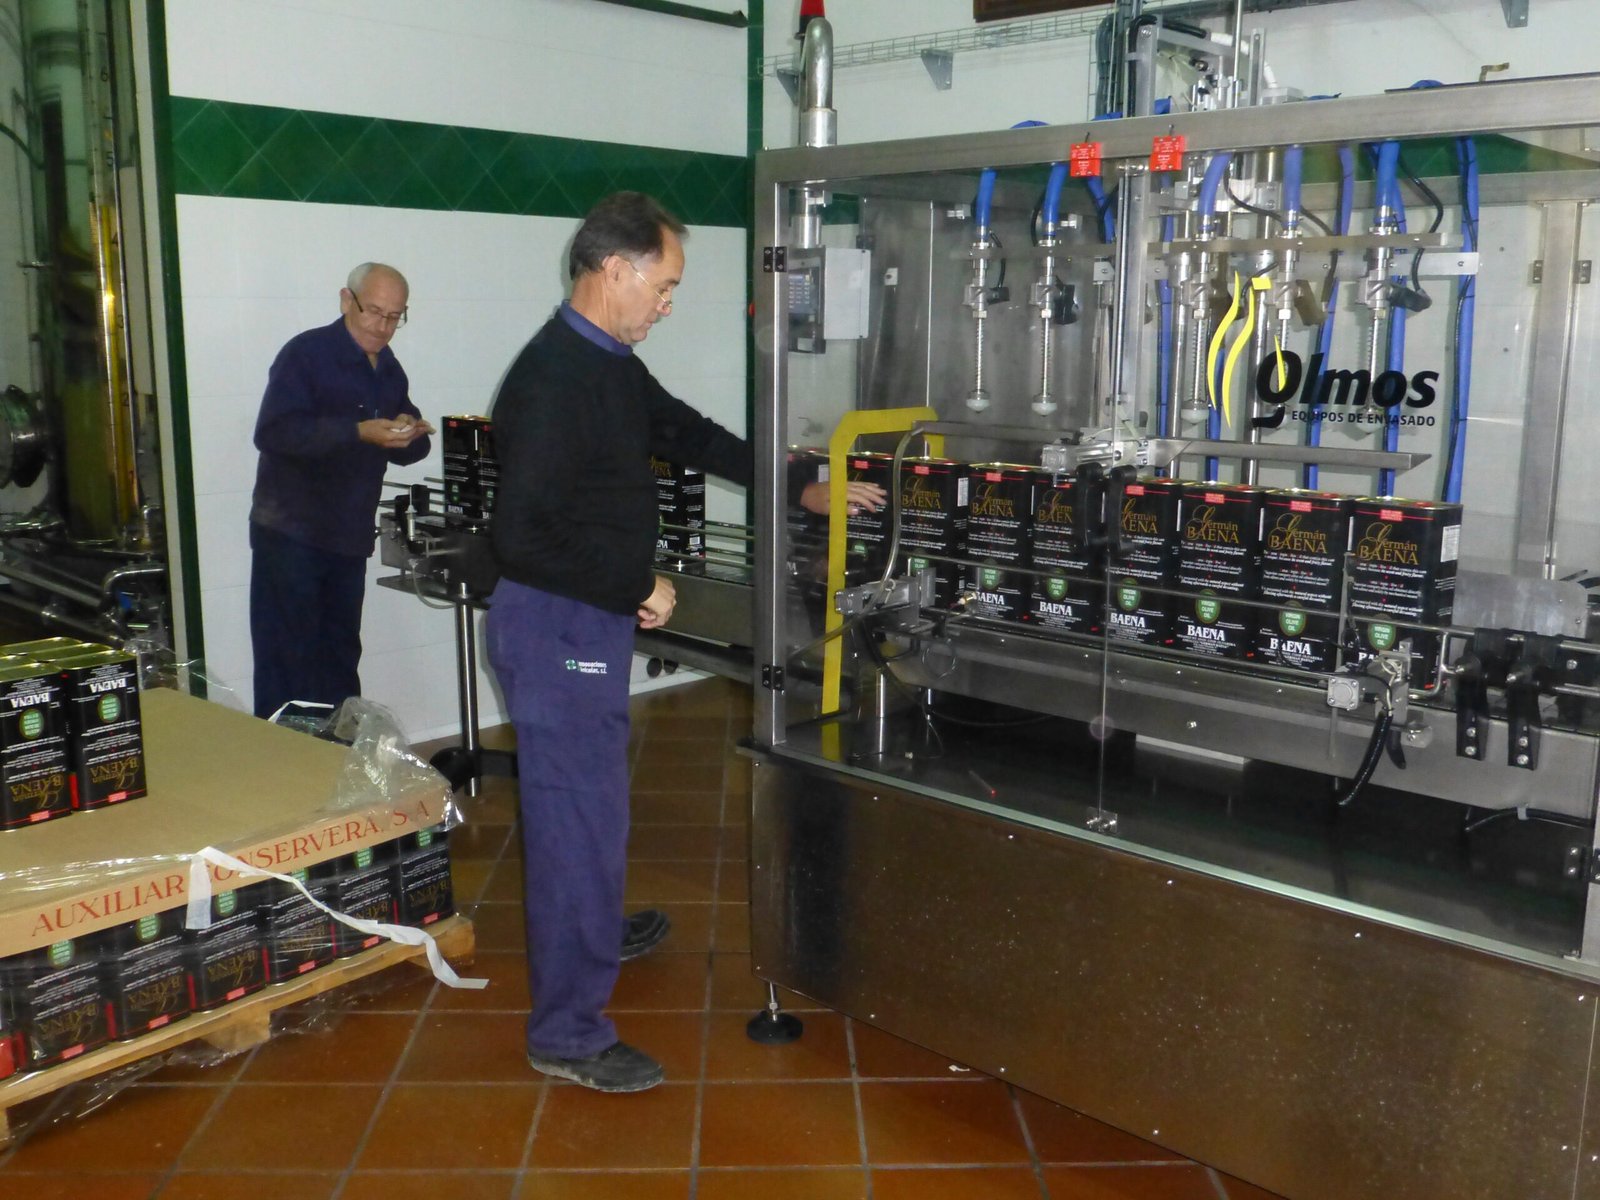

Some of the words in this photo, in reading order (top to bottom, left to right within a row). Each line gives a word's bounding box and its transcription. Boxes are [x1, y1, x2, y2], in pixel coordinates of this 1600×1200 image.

[1250, 349, 1439, 428] Olmos
[1291, 410, 1344, 423] EQUIPOS
[1348, 412, 1363, 423] DE
[1367, 413, 1435, 427] ENVASADO
[972, 502, 1015, 518] BAENA
[1038, 509, 1073, 523] BAEN
[1186, 525, 1240, 544] BAENA
[1269, 534, 1328, 554] BAENA
[1359, 543, 1420, 566] BAENA
[1040, 601, 1072, 616] BAENA
[1110, 612, 1145, 628] BAENA
[1187, 624, 1226, 642] BAENA
[90, 678, 126, 694] BAENA
[10, 692, 50, 709] BAENA
[31, 874, 185, 937] AUXILIAR
